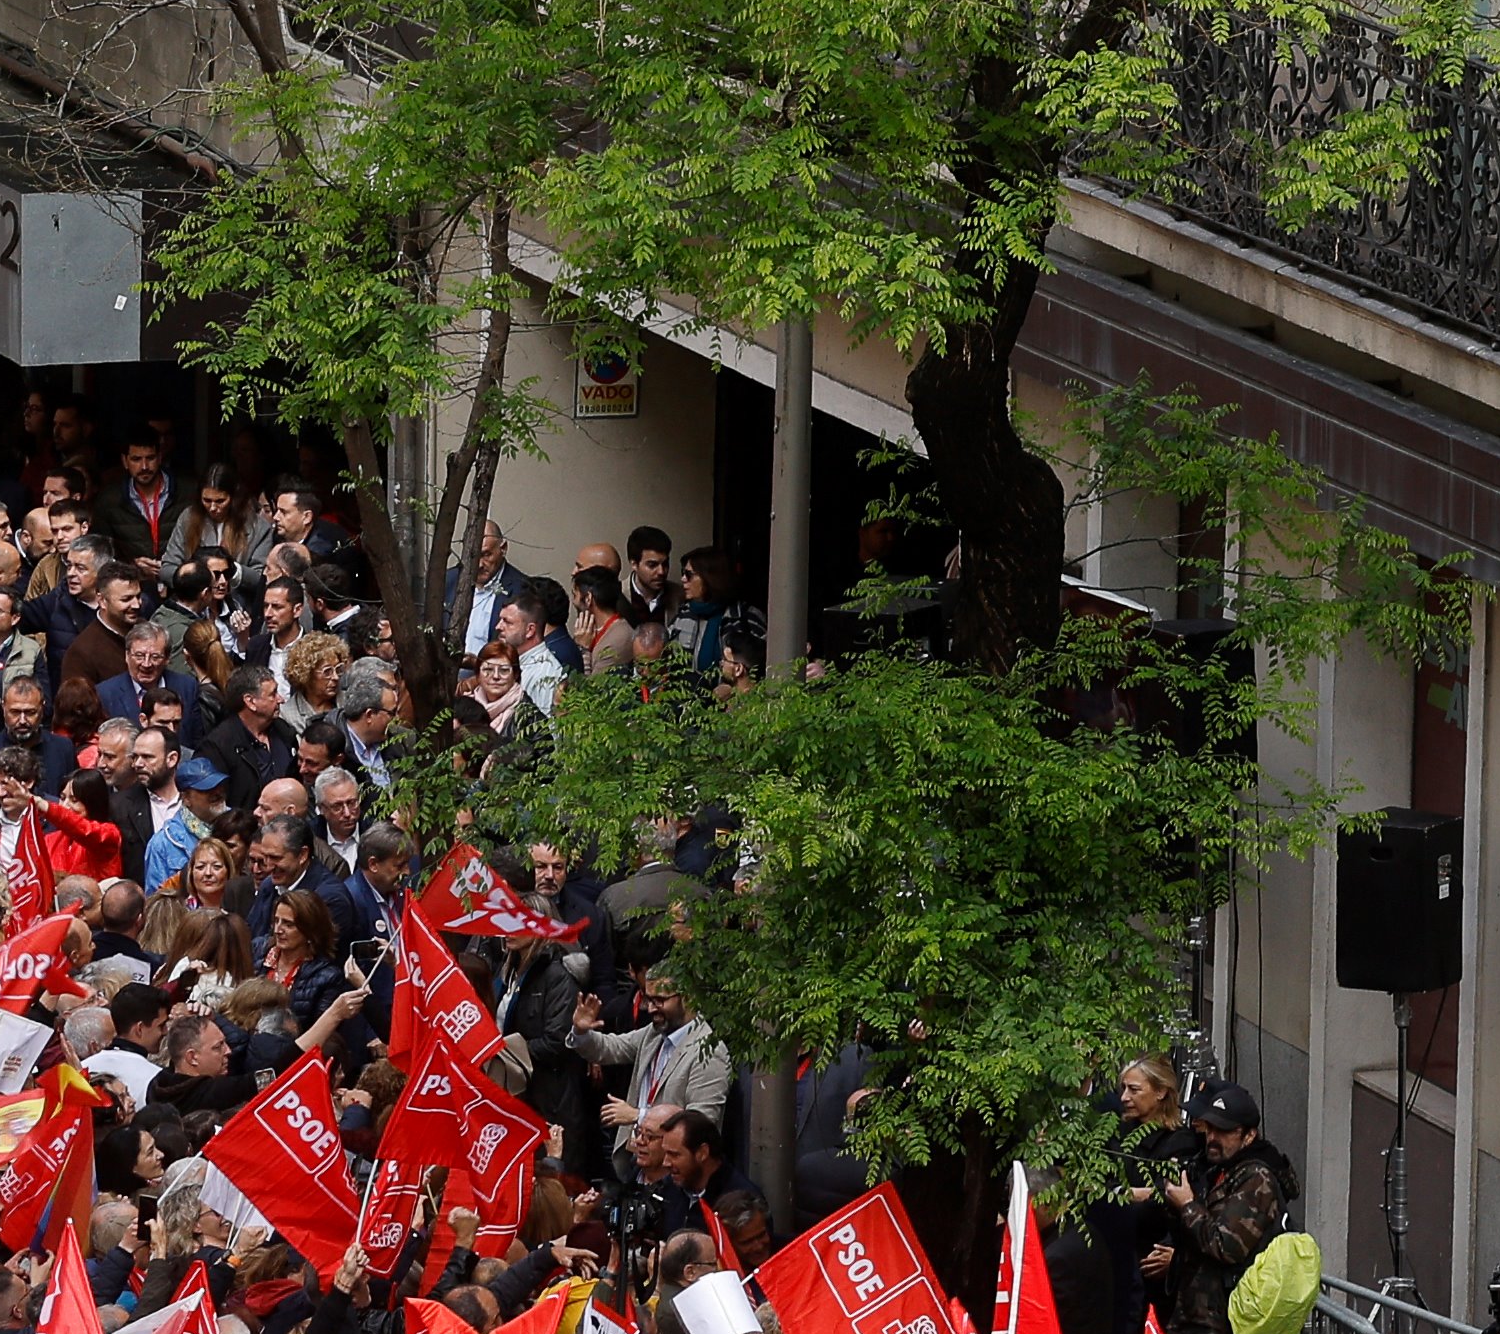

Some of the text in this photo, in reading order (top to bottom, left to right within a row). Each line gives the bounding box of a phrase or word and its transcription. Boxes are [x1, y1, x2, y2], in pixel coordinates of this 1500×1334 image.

[581, 385, 633, 400] VADO
[276, 1092, 333, 1154] PSOE
[824, 1228, 884, 1298] PSOE
